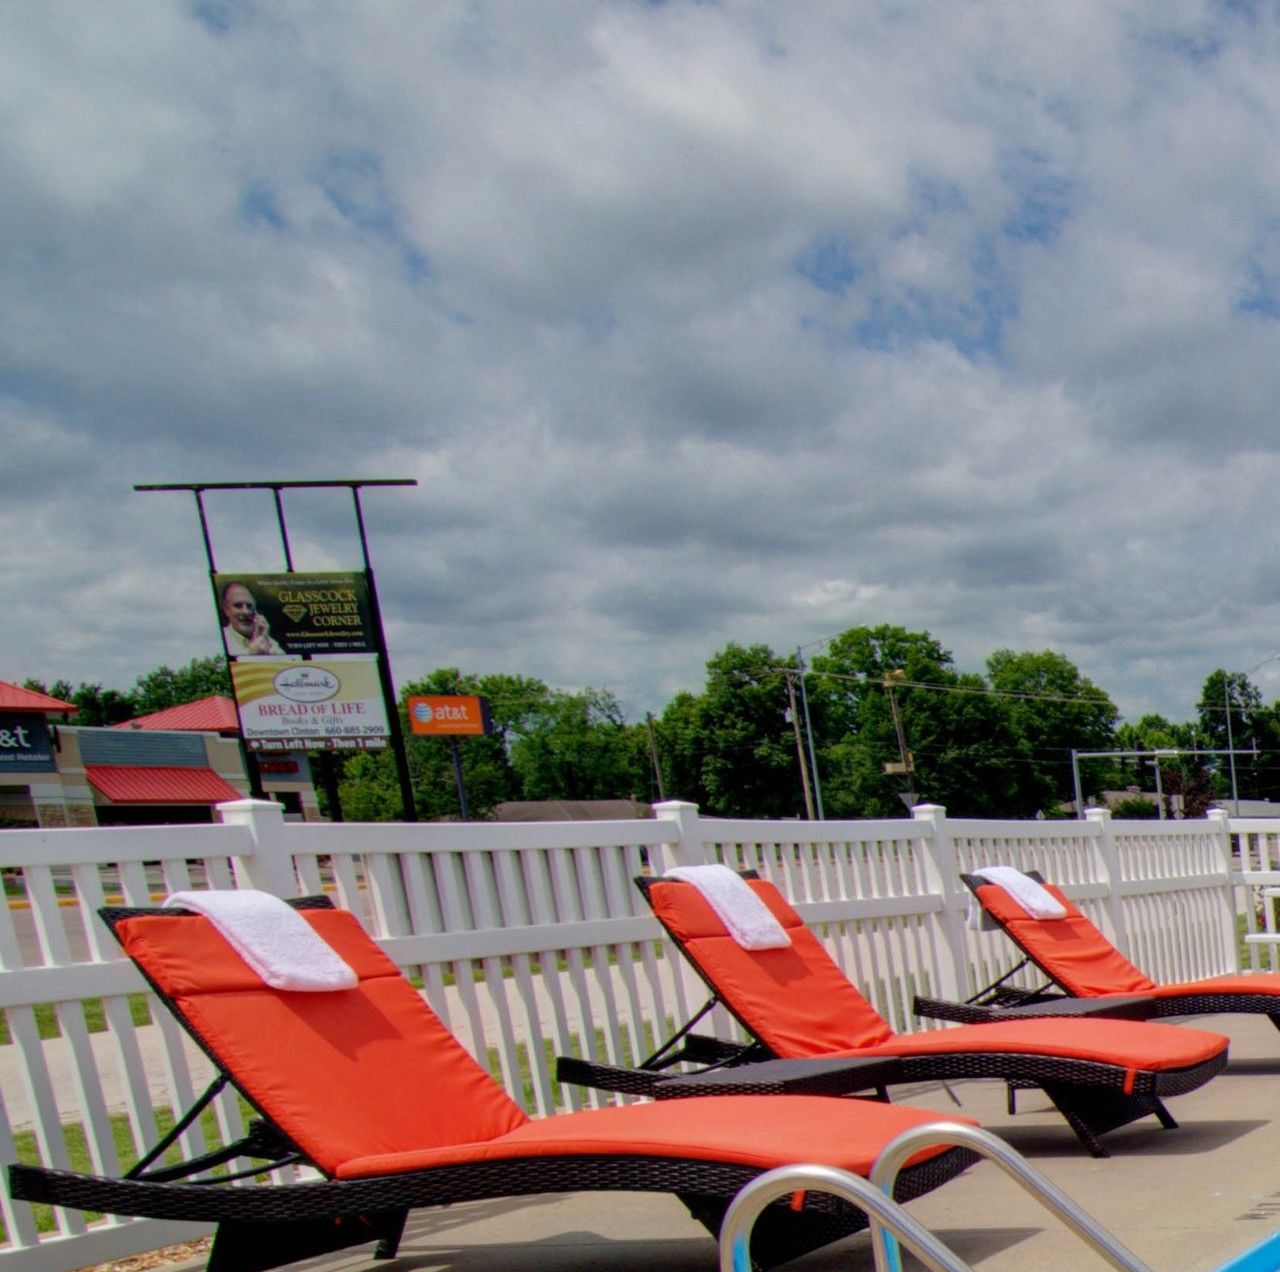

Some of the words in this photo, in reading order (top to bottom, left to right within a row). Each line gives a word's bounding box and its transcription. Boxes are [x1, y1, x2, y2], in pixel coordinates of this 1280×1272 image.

[277, 589, 358, 602] GLASSCOCK
[308, 602, 358, 616] JEWELRY
[312, 615, 362, 627] CORNER
[258, 703, 308, 716] BREAD
[311, 703, 326, 715] OF
[332, 702, 366, 715] LIFE
[434, 704, 469, 721] at&t
[281, 717, 310, 726] Books
[247, 727, 290, 737] Downtown
[291, 727, 320, 736] Clinton
[261, 739, 283, 749] Turn
[284, 739, 304, 749] Left
